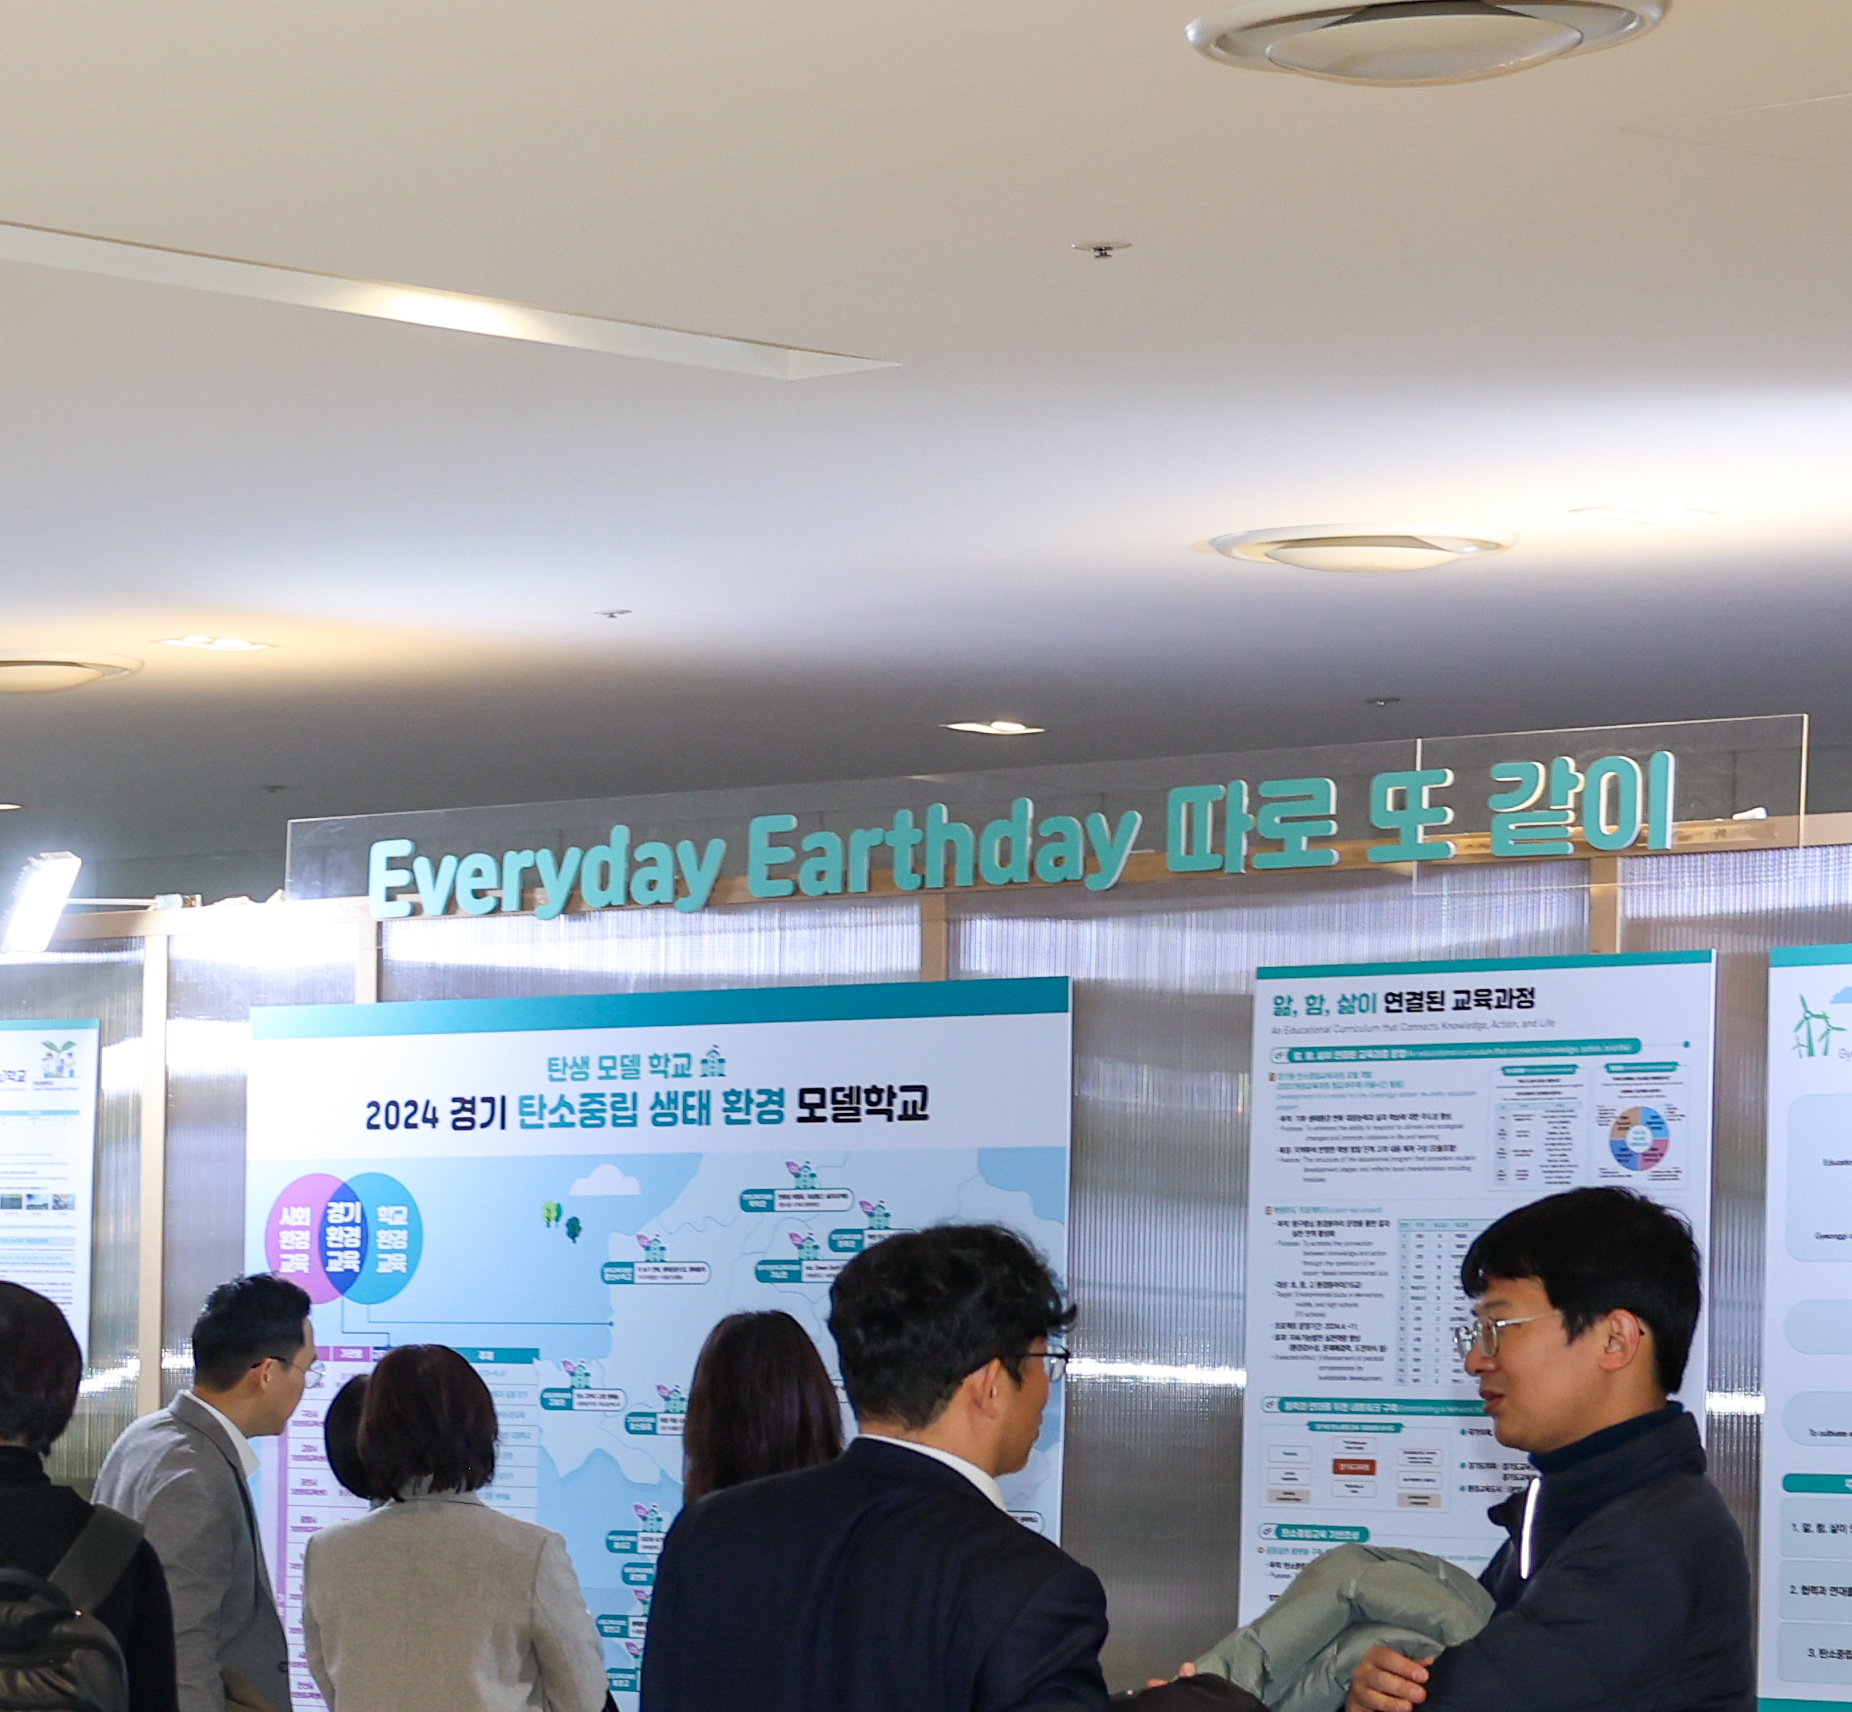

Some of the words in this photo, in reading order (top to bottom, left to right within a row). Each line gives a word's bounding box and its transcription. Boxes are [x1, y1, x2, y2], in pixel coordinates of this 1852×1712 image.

[369, 824, 726, 920] Everyday
[748, 797, 1142, 899] Earthday
[1166, 777, 1340, 875] 따로
[1367, 767, 1457, 863] 또
[1488, 750, 1676, 857] 같이
[1273, 995, 1298, 1018] 앎,
[1305, 994, 1330, 1016] 함,
[1337, 992, 1378, 1014] 삶이
[1384, 990, 1445, 1014] 연결된
[1452, 987, 1535, 1011] 교육과정
[547, 1055, 590, 1081] 탄생
[598, 1054, 641, 1080] 모델
[649, 1052, 692, 1079] 학교
[366, 1099, 439, 1131] 2024
[450, 1095, 507, 1131] 경기
[518, 1091, 638, 1130] 탄소중립
[650, 1089, 711, 1127] 생태
[722, 1087, 785, 1125] 환경
[796, 1083, 929, 1123] 모델학교
[279, 1205, 311, 1227] 사회
[326, 1201, 361, 1223] 경기
[376, 1204, 409, 1226] 학교
[279, 1229, 310, 1250] 환경
[325, 1225, 362, 1247] 환경
[376, 1229, 409, 1250] 환경
[279, 1253, 310, 1274] 교육
[325, 1250, 361, 1273] 교육
[376, 1253, 408, 1274] 교육
